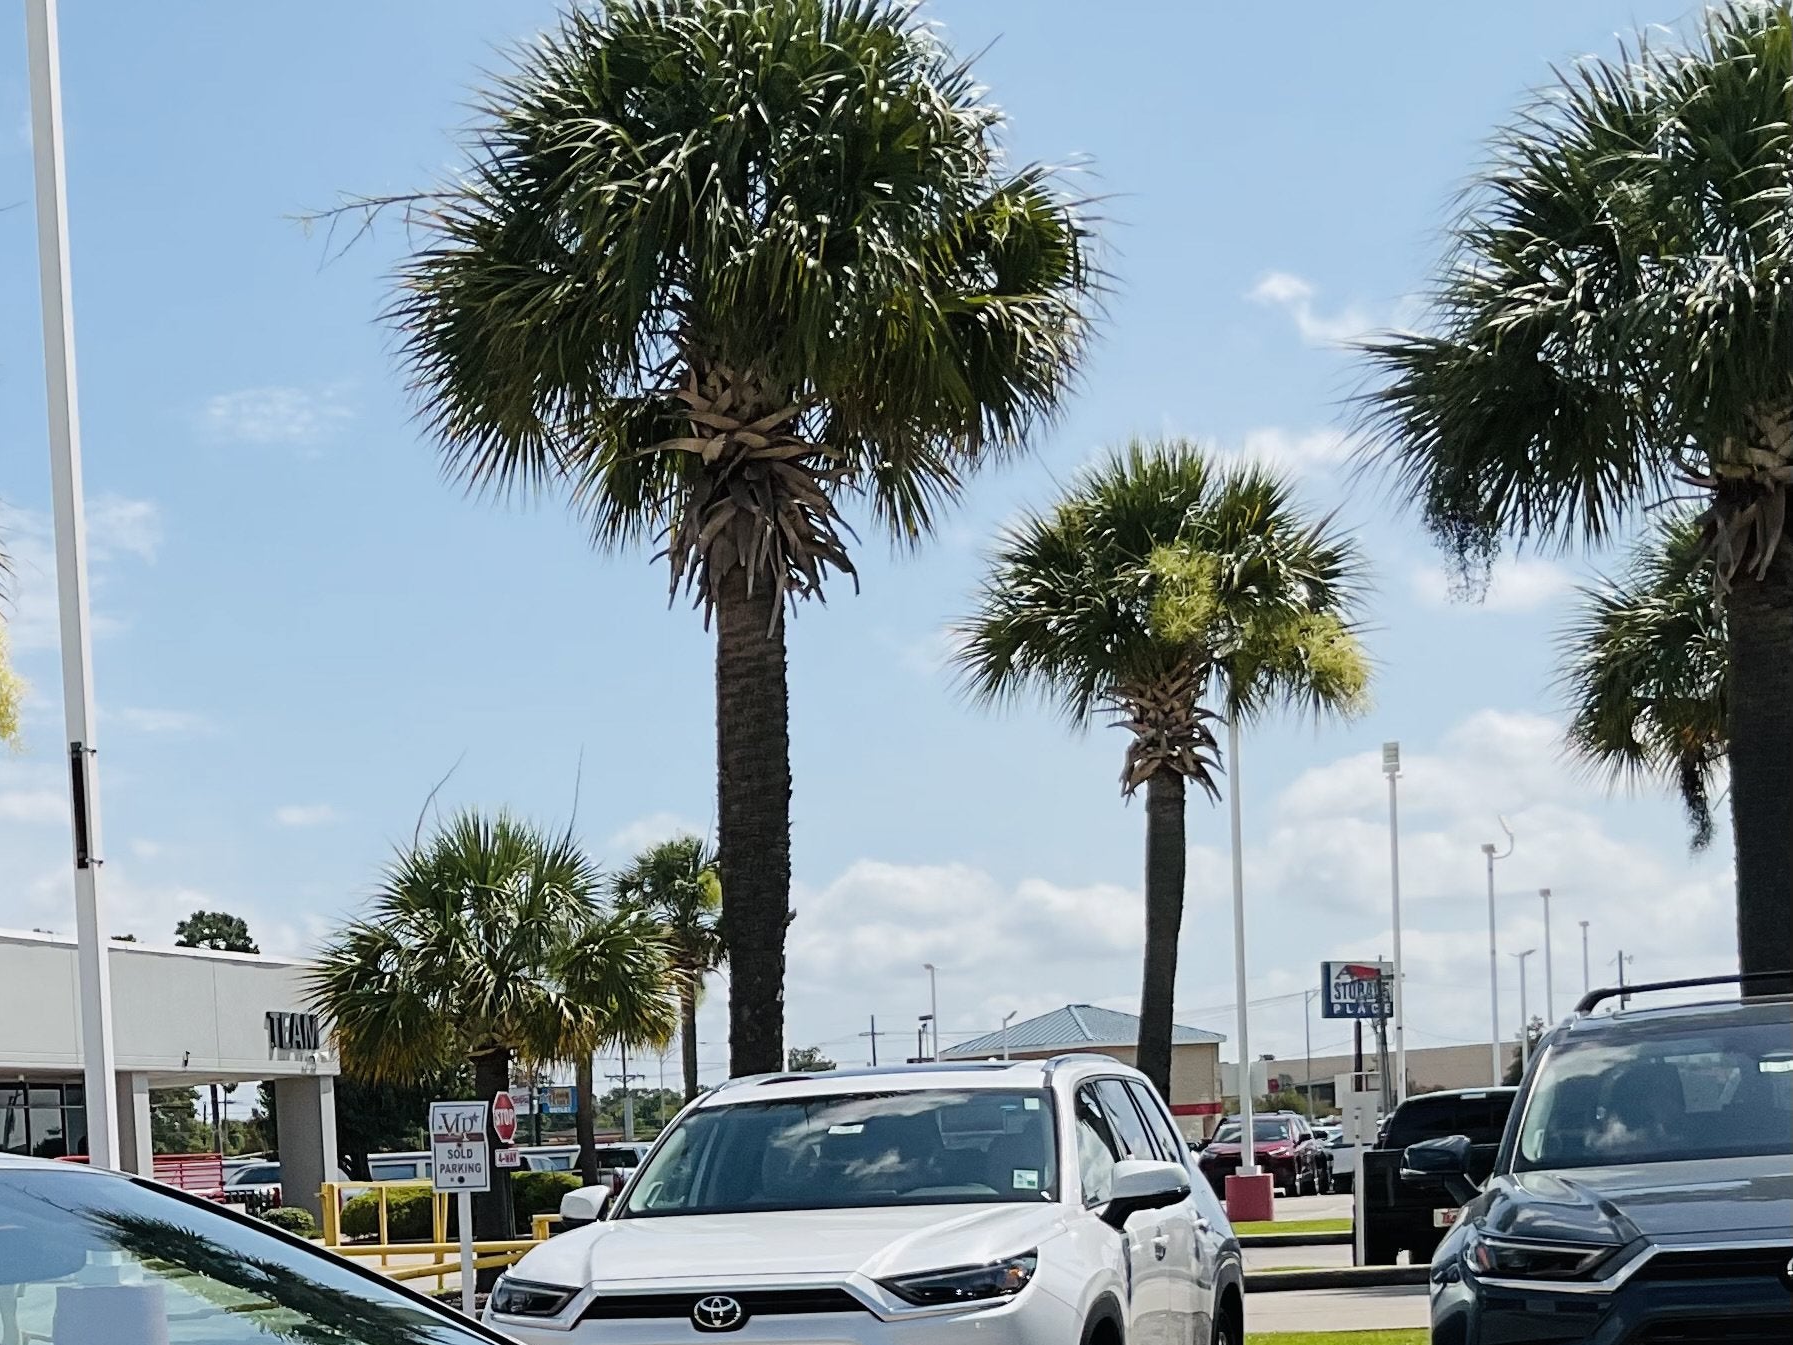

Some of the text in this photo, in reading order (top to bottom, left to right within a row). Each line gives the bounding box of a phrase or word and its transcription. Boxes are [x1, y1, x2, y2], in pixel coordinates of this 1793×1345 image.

[1333, 1003, 1390, 1014] PLACE
[265, 1011, 320, 1050] TEAM
[495, 1108, 515, 1126] STOP
[447, 1149, 473, 1159] SOLD
[498, 1150, 517, 1163] 4-WAY
[439, 1162, 482, 1174] PARKING
